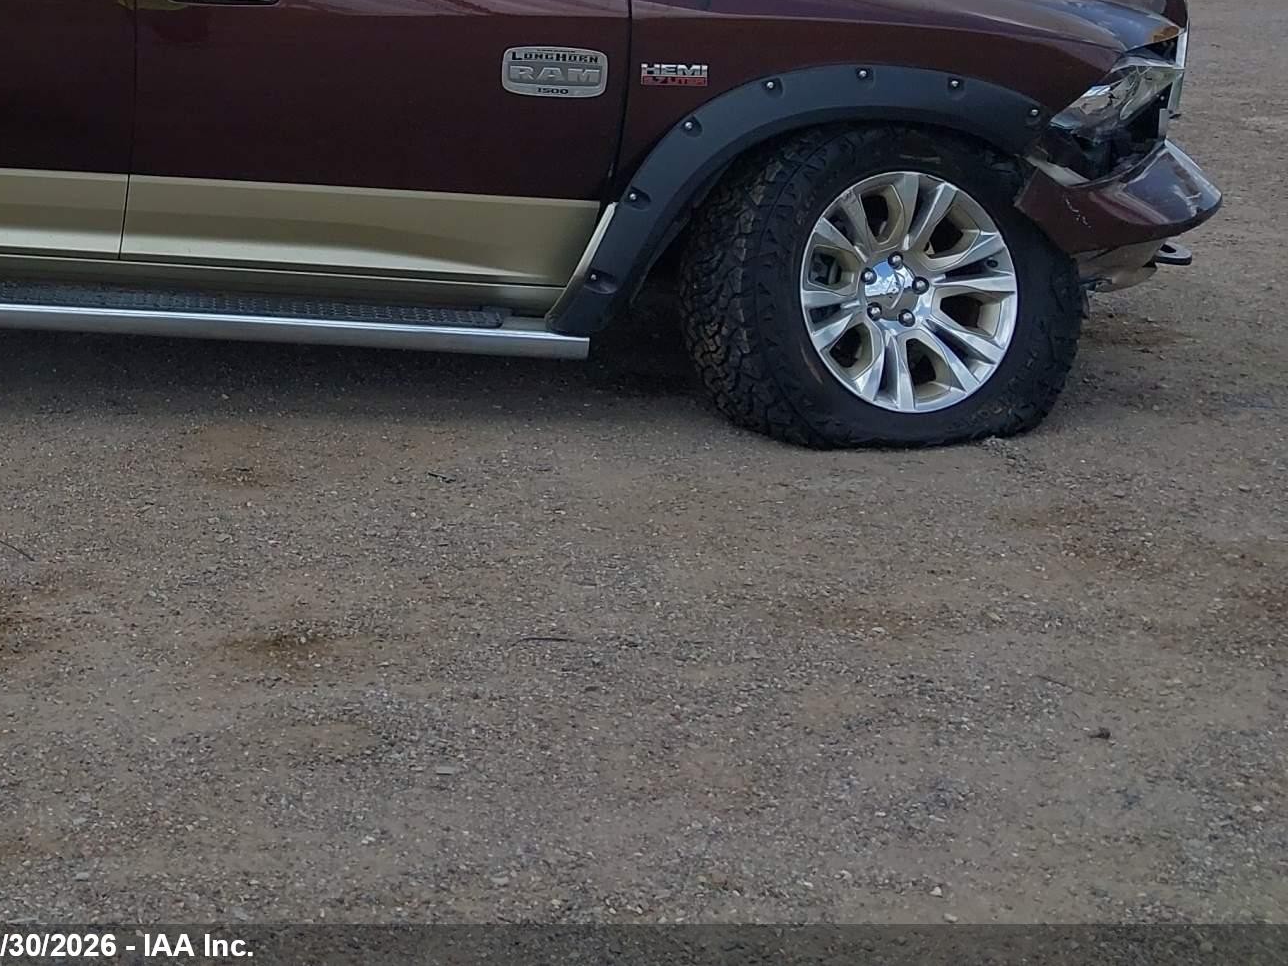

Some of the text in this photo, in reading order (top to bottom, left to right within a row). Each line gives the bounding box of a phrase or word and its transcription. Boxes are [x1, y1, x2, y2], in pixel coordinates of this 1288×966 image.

[509, 65, 601, 83] RAM
[641, 64, 708, 77] HEMI
[537, 87, 569, 95] 1500
